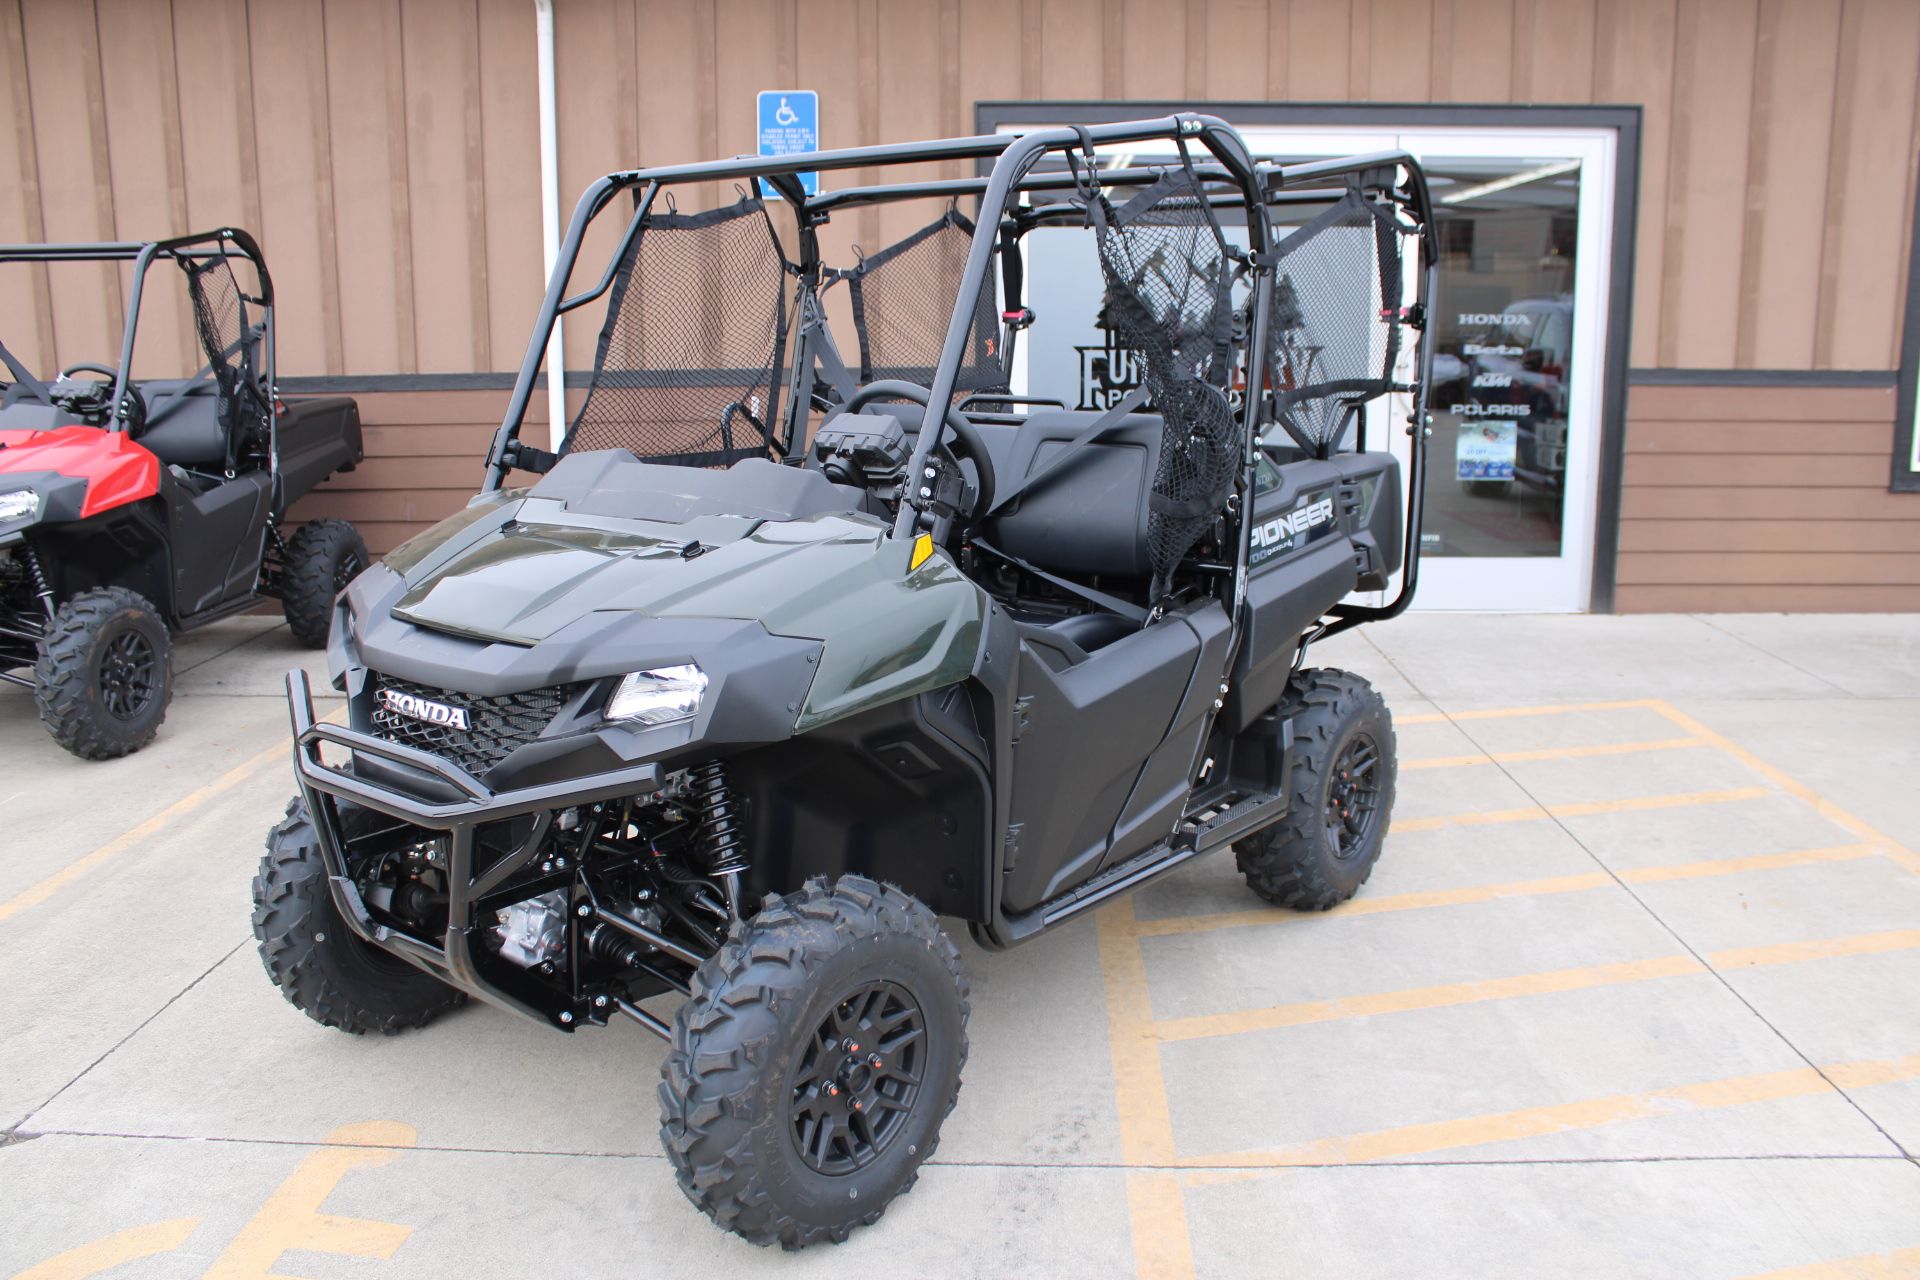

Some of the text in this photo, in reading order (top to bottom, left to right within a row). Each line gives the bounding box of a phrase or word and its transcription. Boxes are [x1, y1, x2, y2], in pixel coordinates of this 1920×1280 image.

[1458, 313, 1531, 325] HONDA
[1472, 372, 1513, 387] KTM
[1450, 404, 1531, 416] POLARIS
[1250, 498, 1333, 548] PIONEER
[384, 689, 468, 731] HONDA
